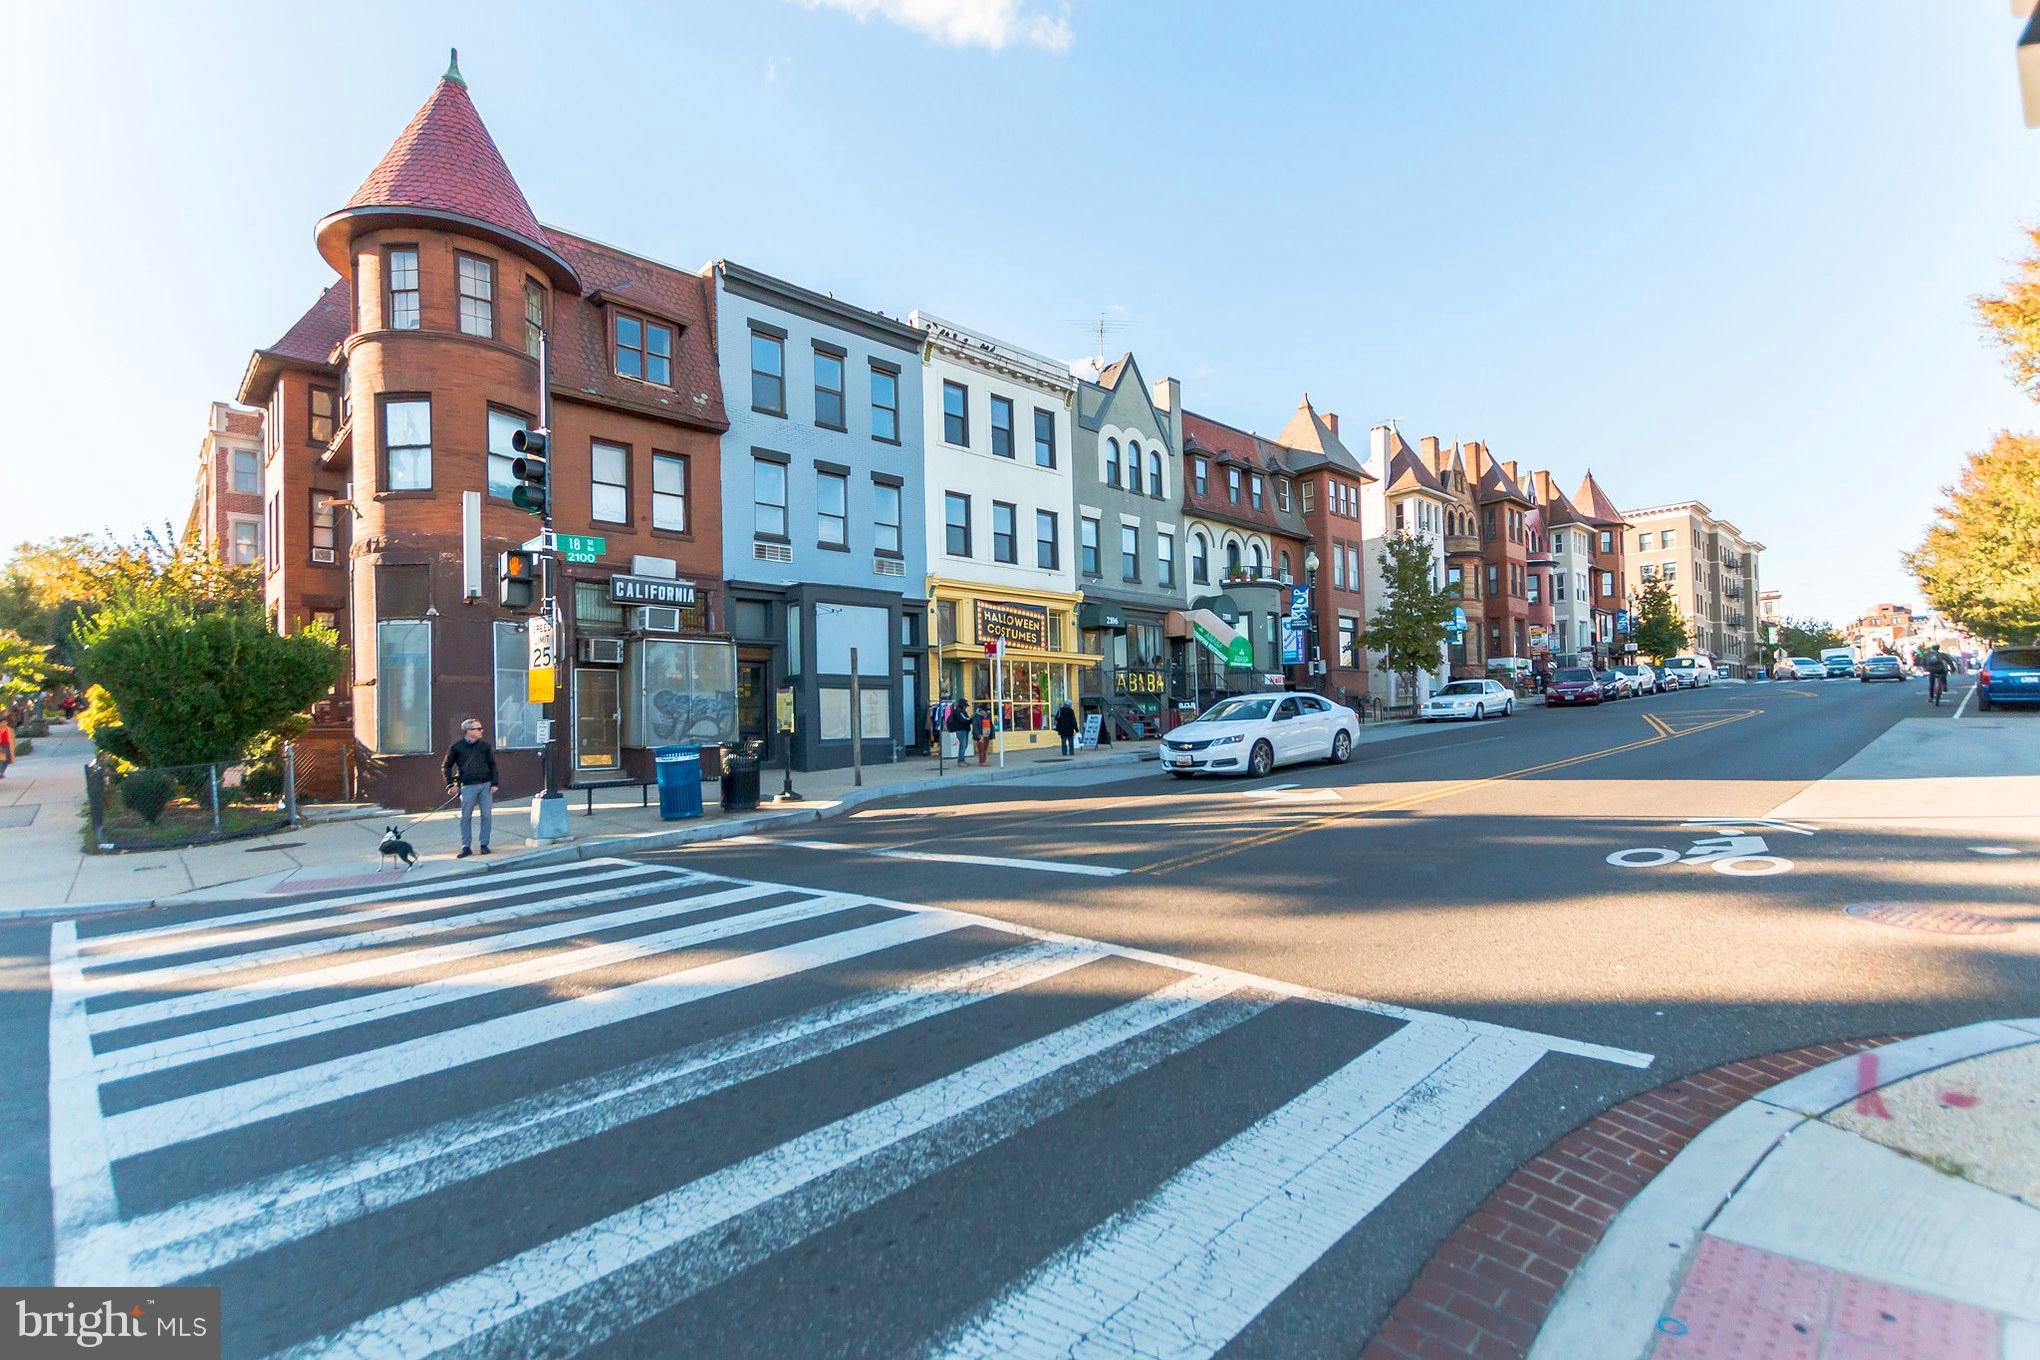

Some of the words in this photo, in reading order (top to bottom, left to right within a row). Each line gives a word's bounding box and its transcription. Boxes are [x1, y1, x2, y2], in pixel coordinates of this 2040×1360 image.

[569, 538, 581, 551] 18
[568, 552, 596, 563] 2100
[616, 581, 695, 603] CALIFORNIA
[1292, 588, 1309, 620] SHOP
[983, 610, 1040, 631] HALLOWEEN
[987, 623, 1037, 643] COSTUMES
[533, 646, 551, 668] 25
[1116, 673, 1165, 693] ABABA
